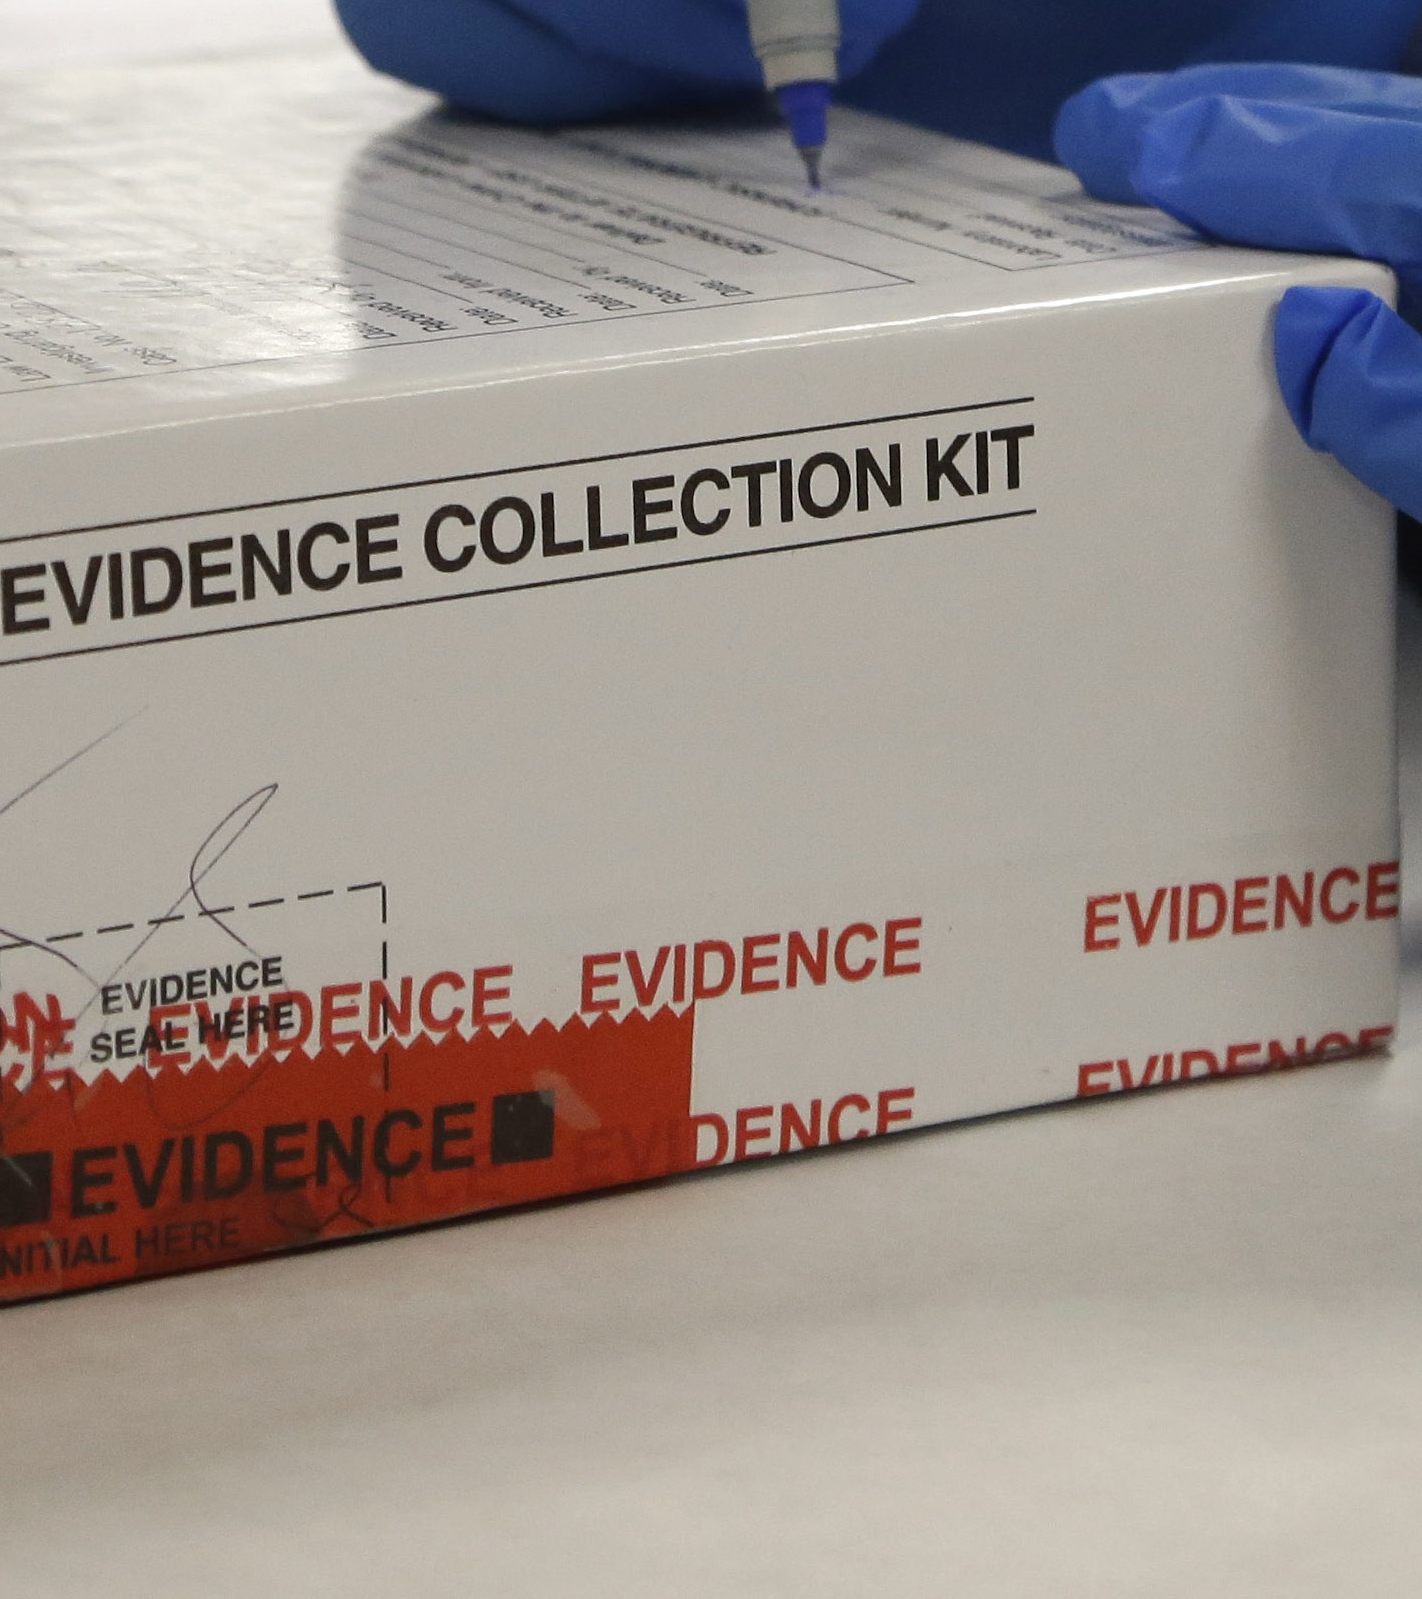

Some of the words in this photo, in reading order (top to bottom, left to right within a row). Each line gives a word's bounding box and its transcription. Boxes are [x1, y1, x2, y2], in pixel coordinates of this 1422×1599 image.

[479, 288, 579, 318] Received
[576, 292, 637, 311] Date:
[596, 275, 697, 304] Received
[693, 279, 755, 297] Date:
[363, 301, 458, 332] Received
[460, 306, 519, 325] Date:
[1, 514, 403, 636] EVIDENCE
[423, 444, 901, 572] COLLECTION
[926, 424, 1035, 501] KIT
[1083, 861, 1401, 953] EVIDENCE
[100, 955, 284, 1016] EVIDENCE
[580, 917, 923, 1014] EVIDENCE
[89, 1019, 186, 1064] SEAL
[198, 1000, 295, 1044] HERE
[147, 964, 514, 1069] EVIDENCE
[71, 1101, 477, 1219] EVIDENCE
[135, 1215, 242, 1261] HERE
